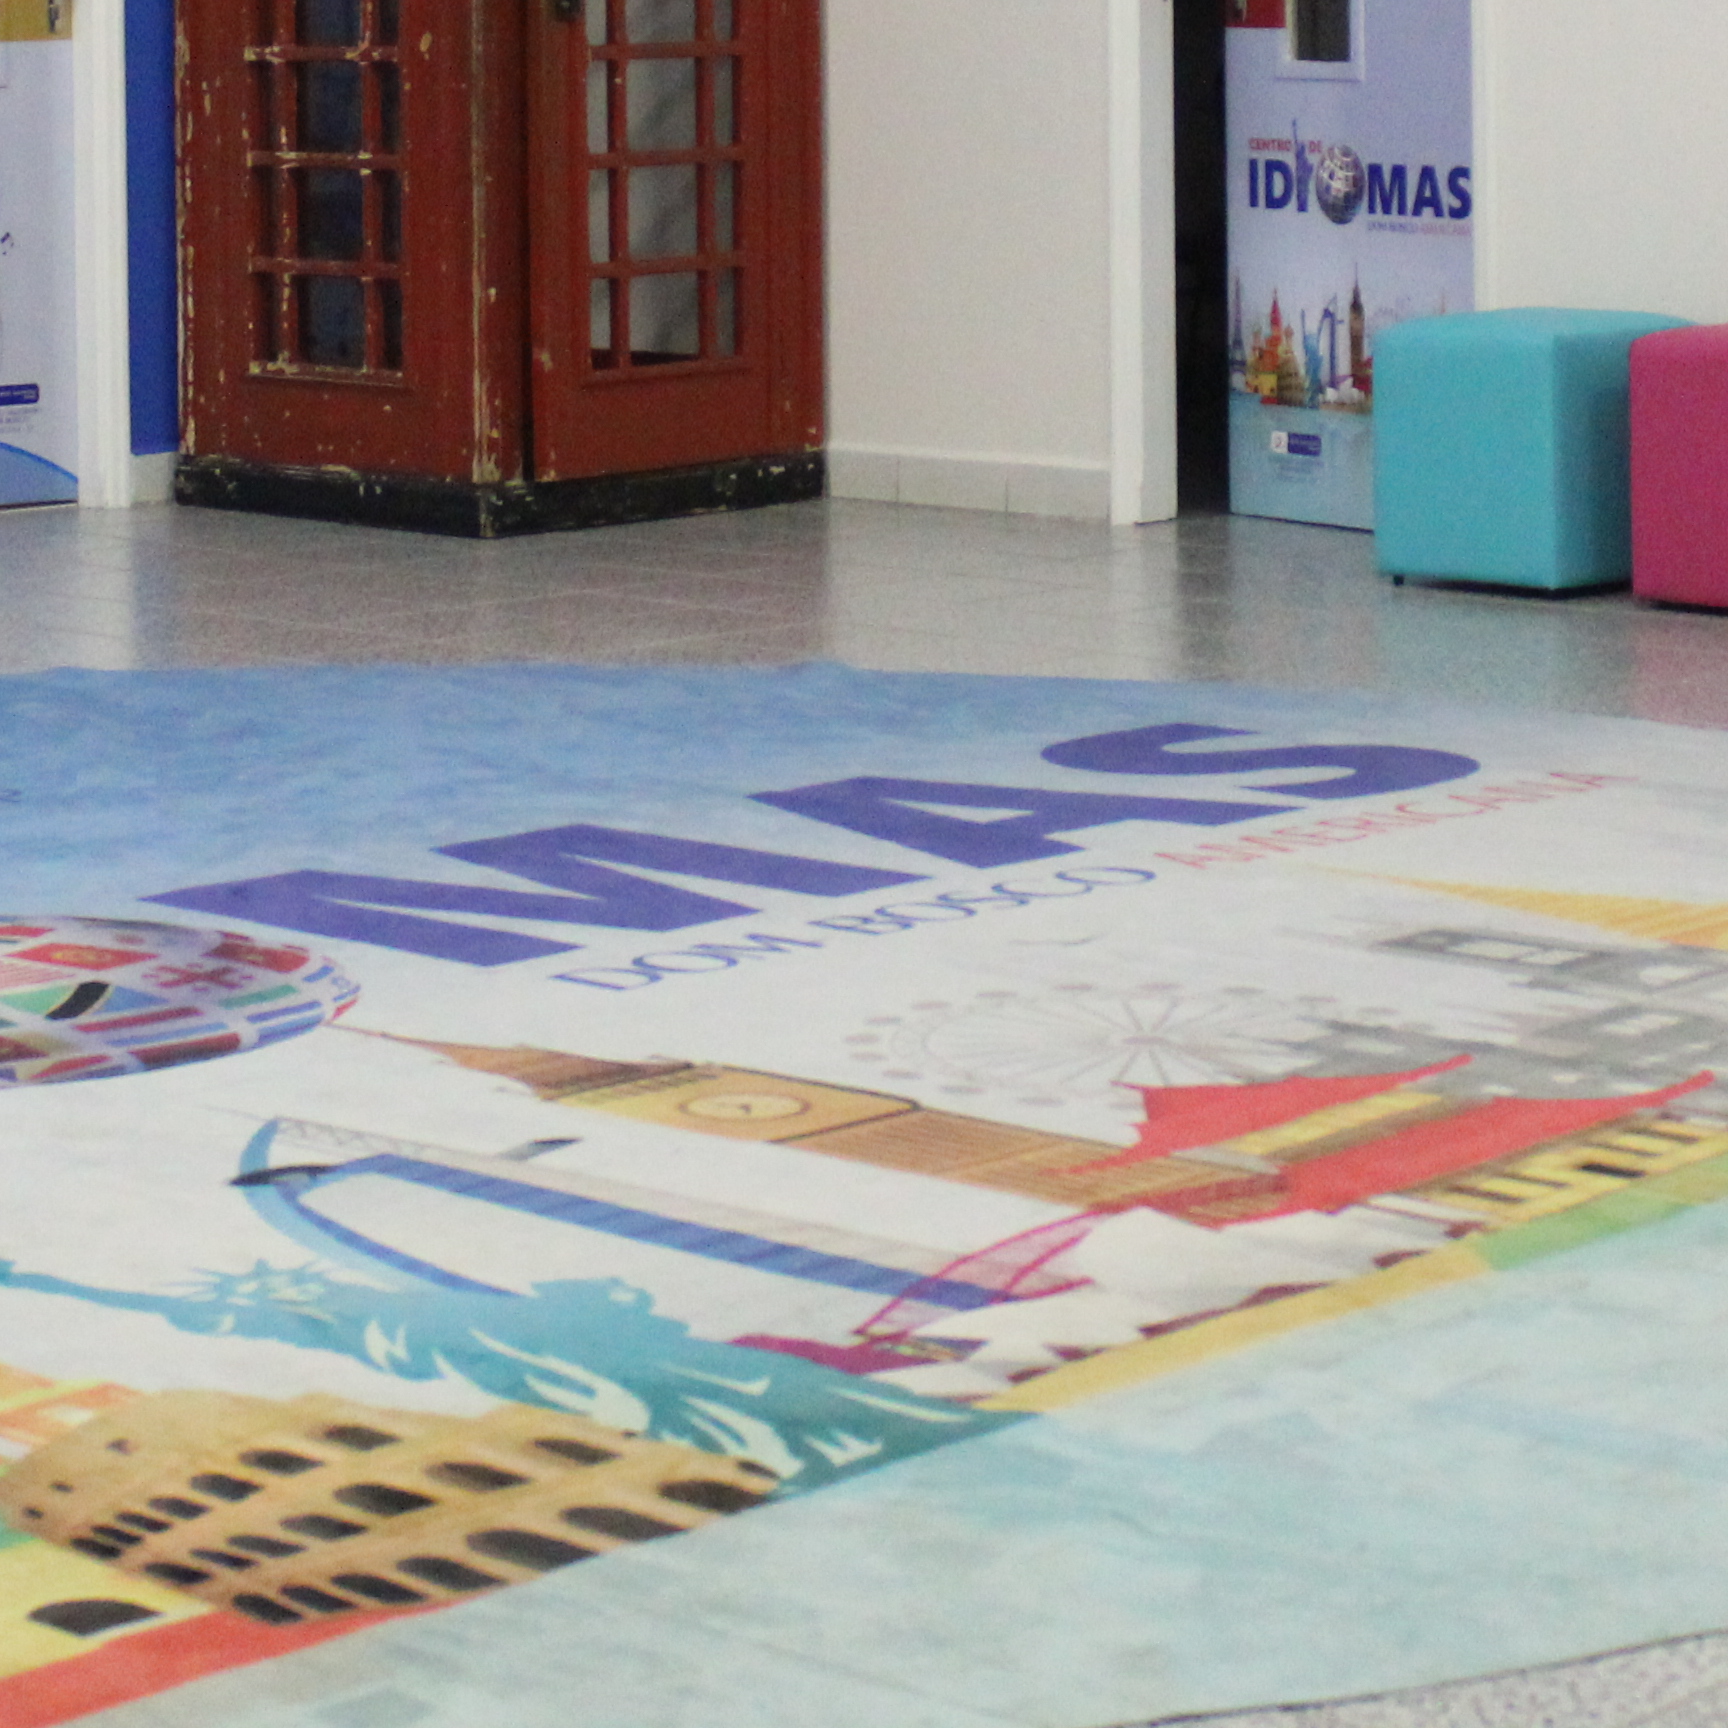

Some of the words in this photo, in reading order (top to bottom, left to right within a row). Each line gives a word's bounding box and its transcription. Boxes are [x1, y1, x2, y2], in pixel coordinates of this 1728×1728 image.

[550, 932, 825, 992] DOM
[806, 865, 1158, 936] BOSCO
[1153, 771, 1642, 870] AMERICANA
